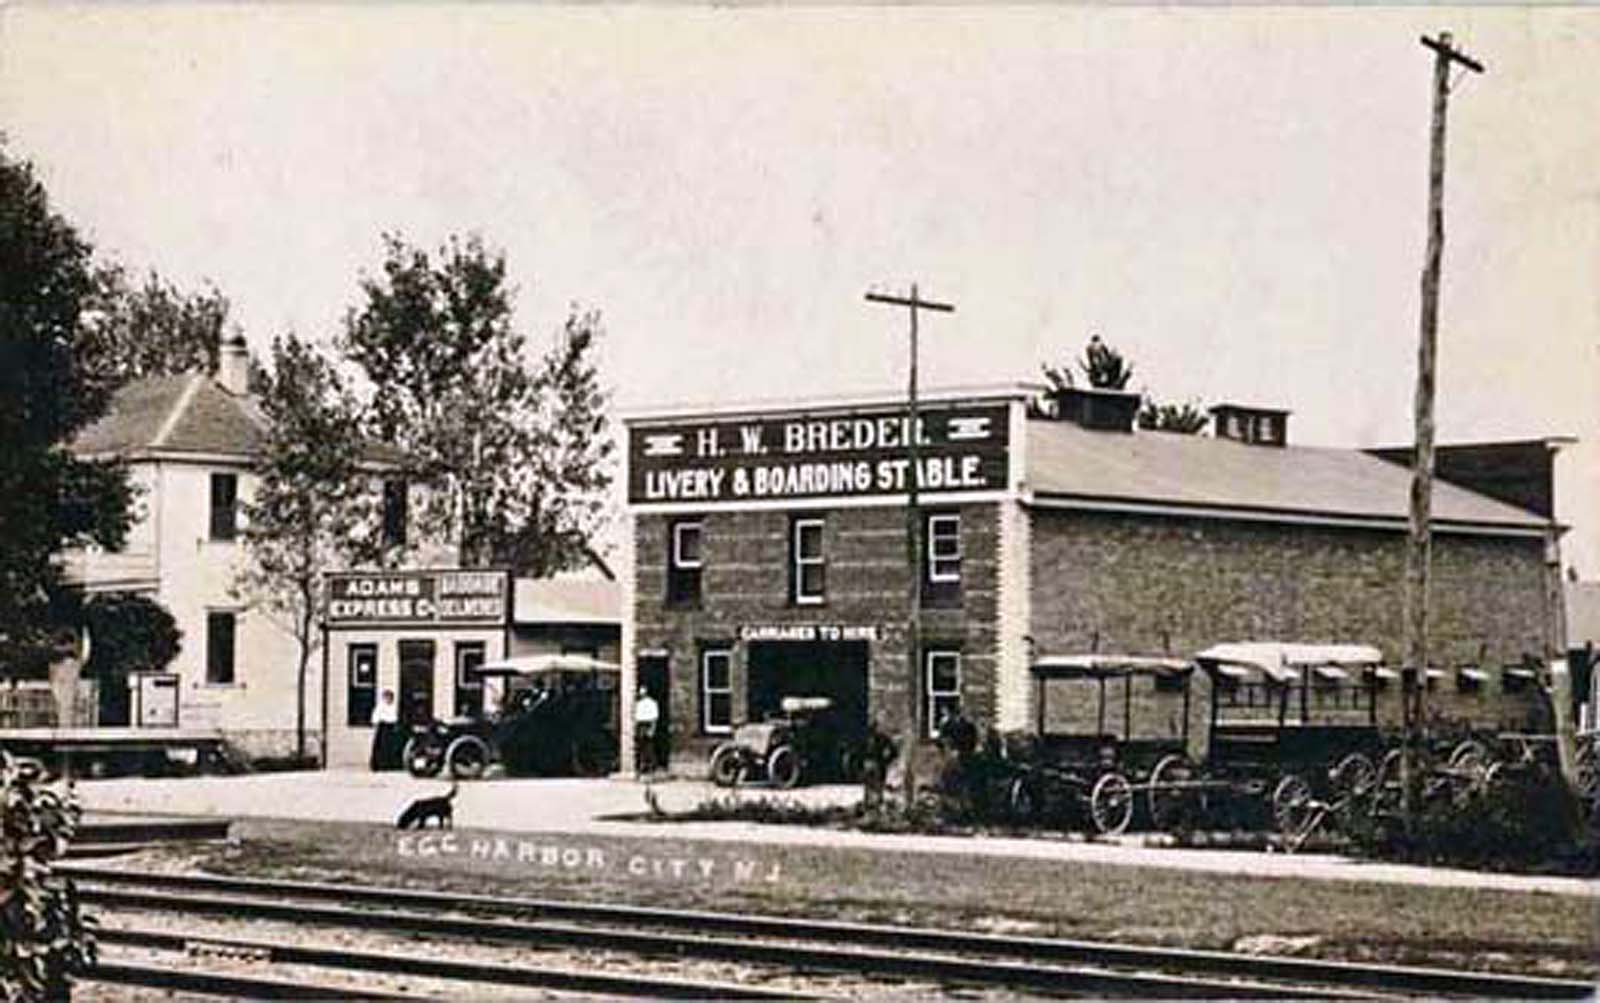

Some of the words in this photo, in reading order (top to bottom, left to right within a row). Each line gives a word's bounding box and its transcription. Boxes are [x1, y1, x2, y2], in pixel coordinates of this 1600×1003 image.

[697, 428, 726, 456] H.
[740, 425, 768, 453] W.
[645, 468, 725, 498] LIVERY
[733, 467, 750, 495] &
[754, 461, 871, 495] BOARDING
[346, 580, 420, 596] ADAMS
[819, 626, 839, 641] TO
